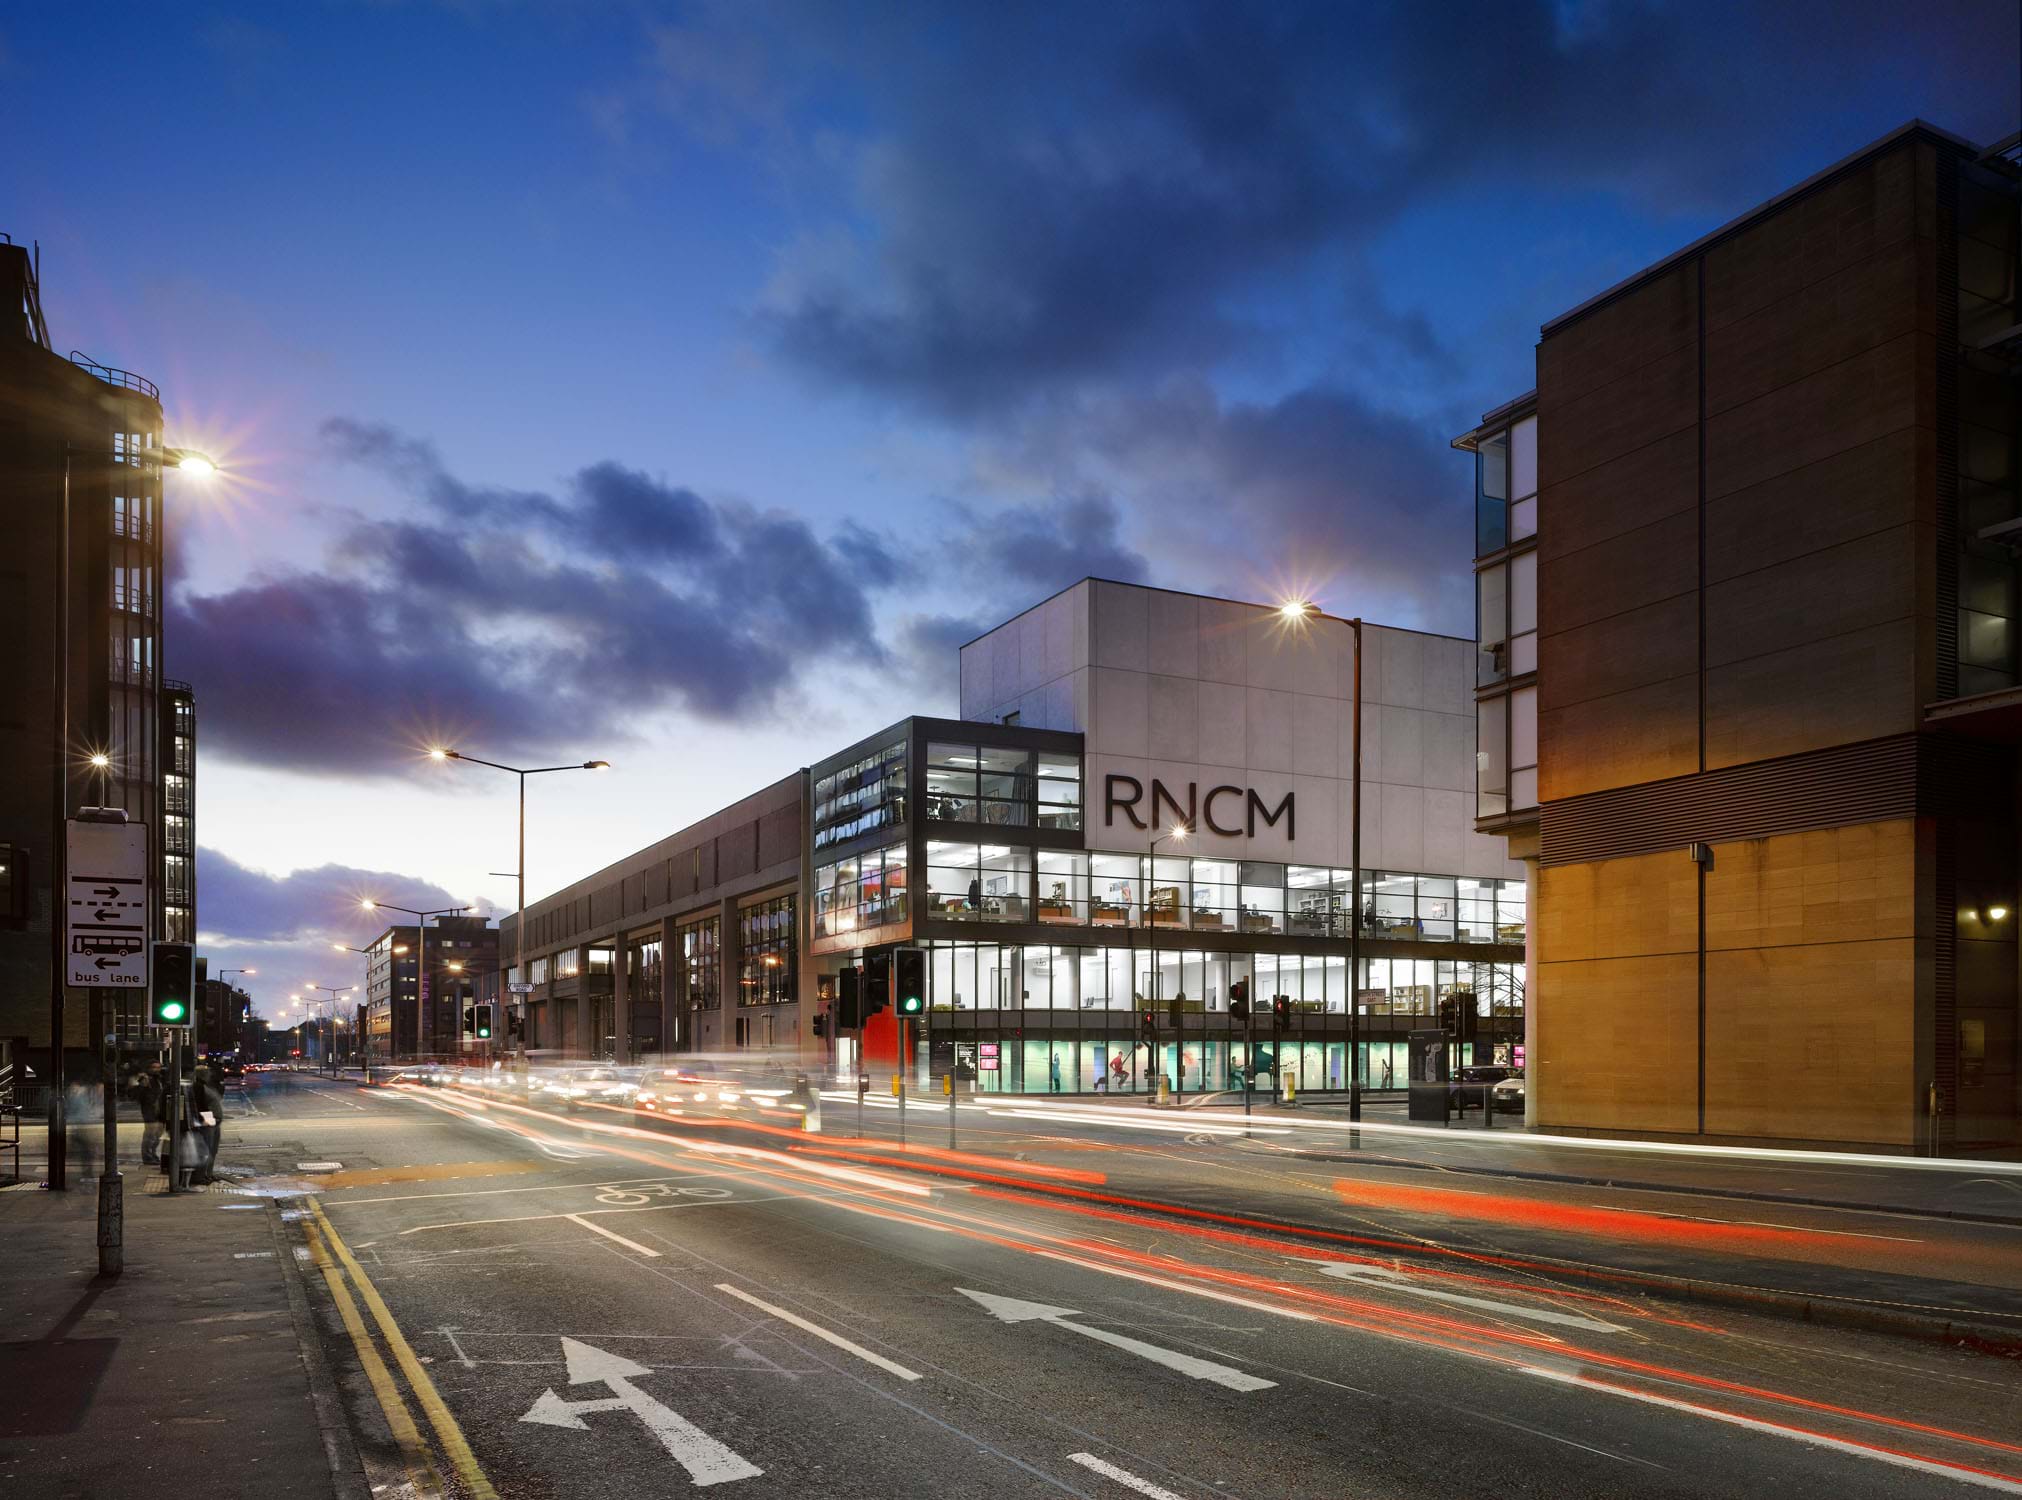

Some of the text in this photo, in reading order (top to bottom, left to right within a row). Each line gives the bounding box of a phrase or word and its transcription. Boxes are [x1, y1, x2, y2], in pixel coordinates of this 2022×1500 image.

[1105, 774, 1295, 841] RNCM
[75, 972, 140, 983] bus lane
